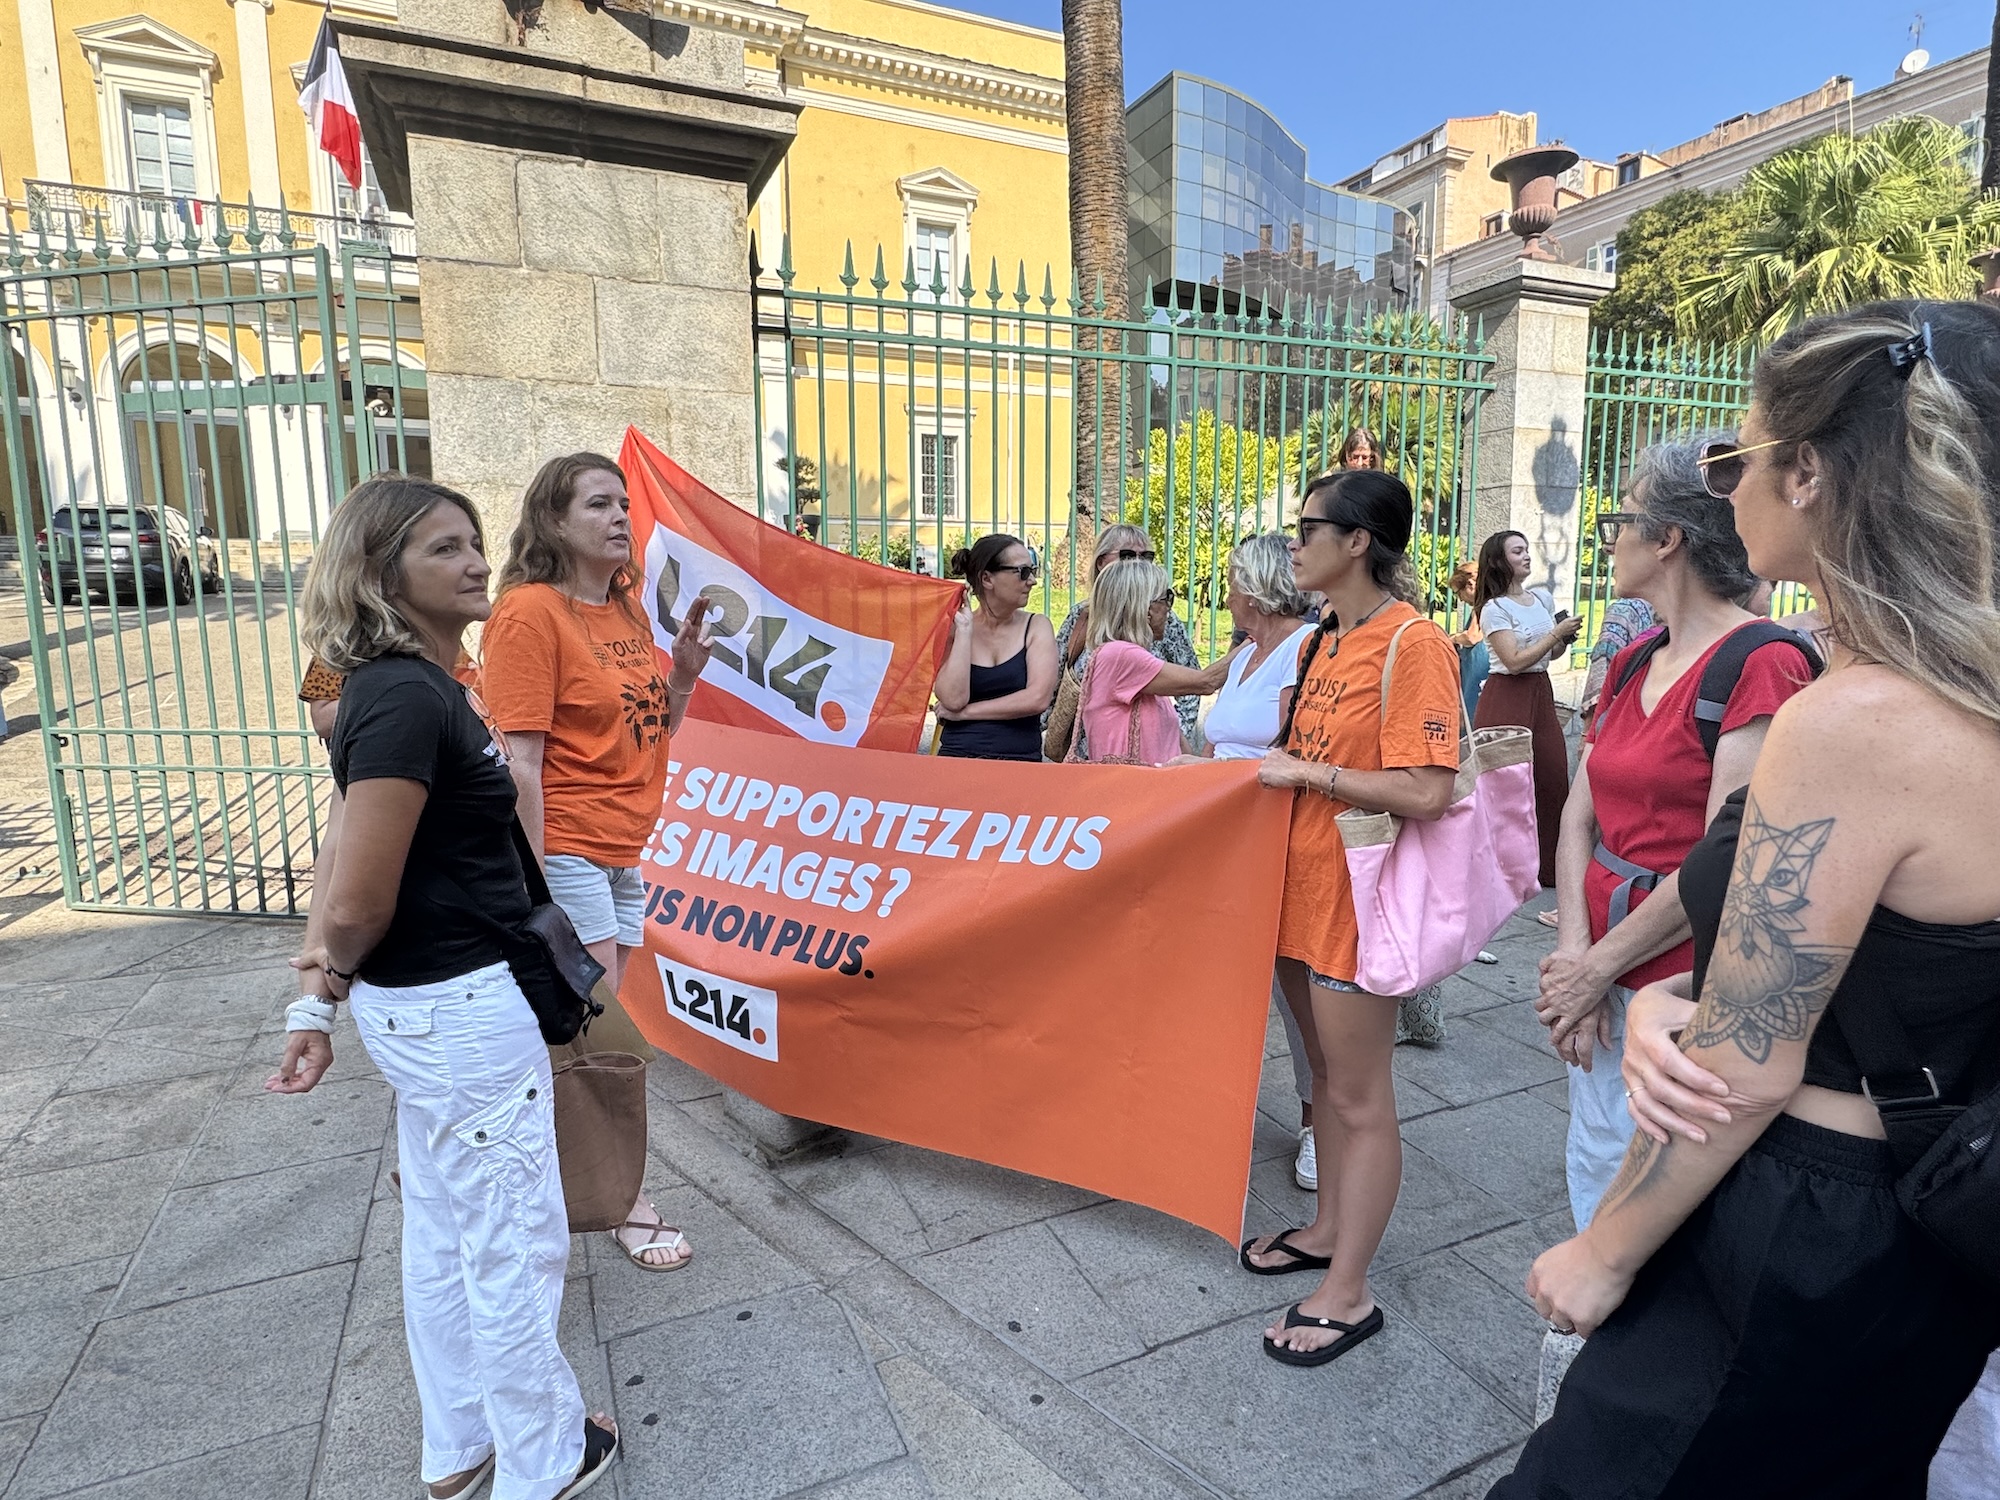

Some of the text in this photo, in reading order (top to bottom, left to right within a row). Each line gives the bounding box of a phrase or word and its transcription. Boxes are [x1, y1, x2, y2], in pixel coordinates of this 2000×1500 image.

[676, 766, 973, 859] SUPPORTEZ
[966, 812, 1111, 871] PLUS
[681, 895, 776, 952] NON
[770, 919, 875, 979] PLUS.
